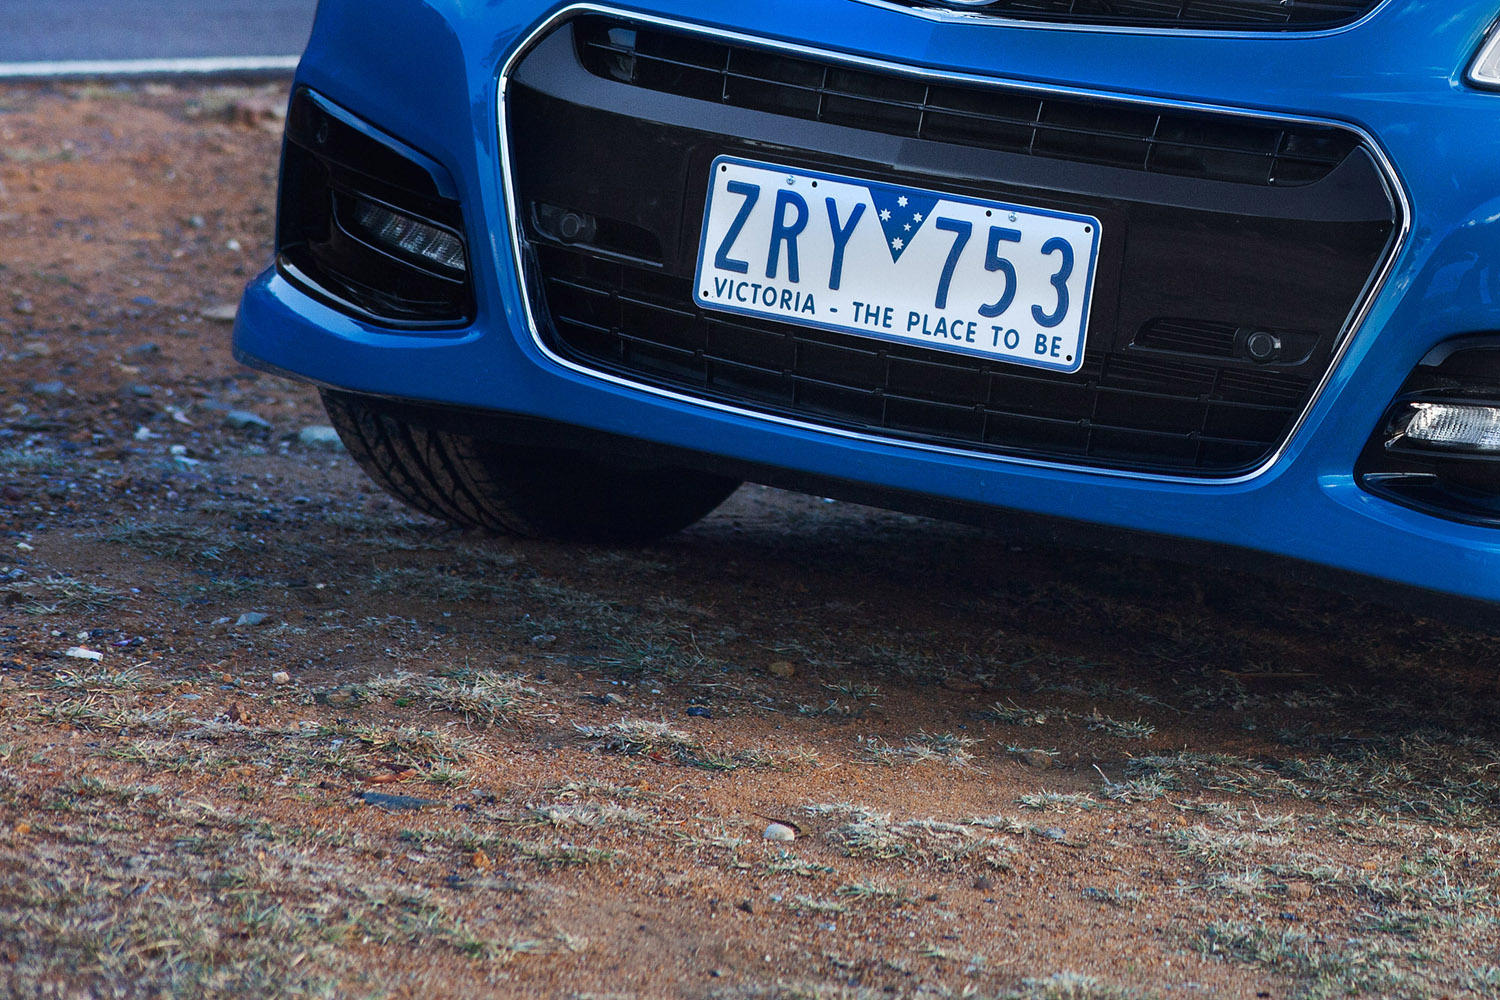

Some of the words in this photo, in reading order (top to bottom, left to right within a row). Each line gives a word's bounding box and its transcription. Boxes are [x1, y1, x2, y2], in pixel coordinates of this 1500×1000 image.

[715, 179, 867, 291] ZRY
[934, 216, 1075, 328] 753
[714, 276, 816, 315] VICTORIA
[852, 301, 894, 329] THE
[906, 311, 978, 343] PLACE
[991, 325, 1020, 350] TO
[1034, 333, 1063, 359] BE
